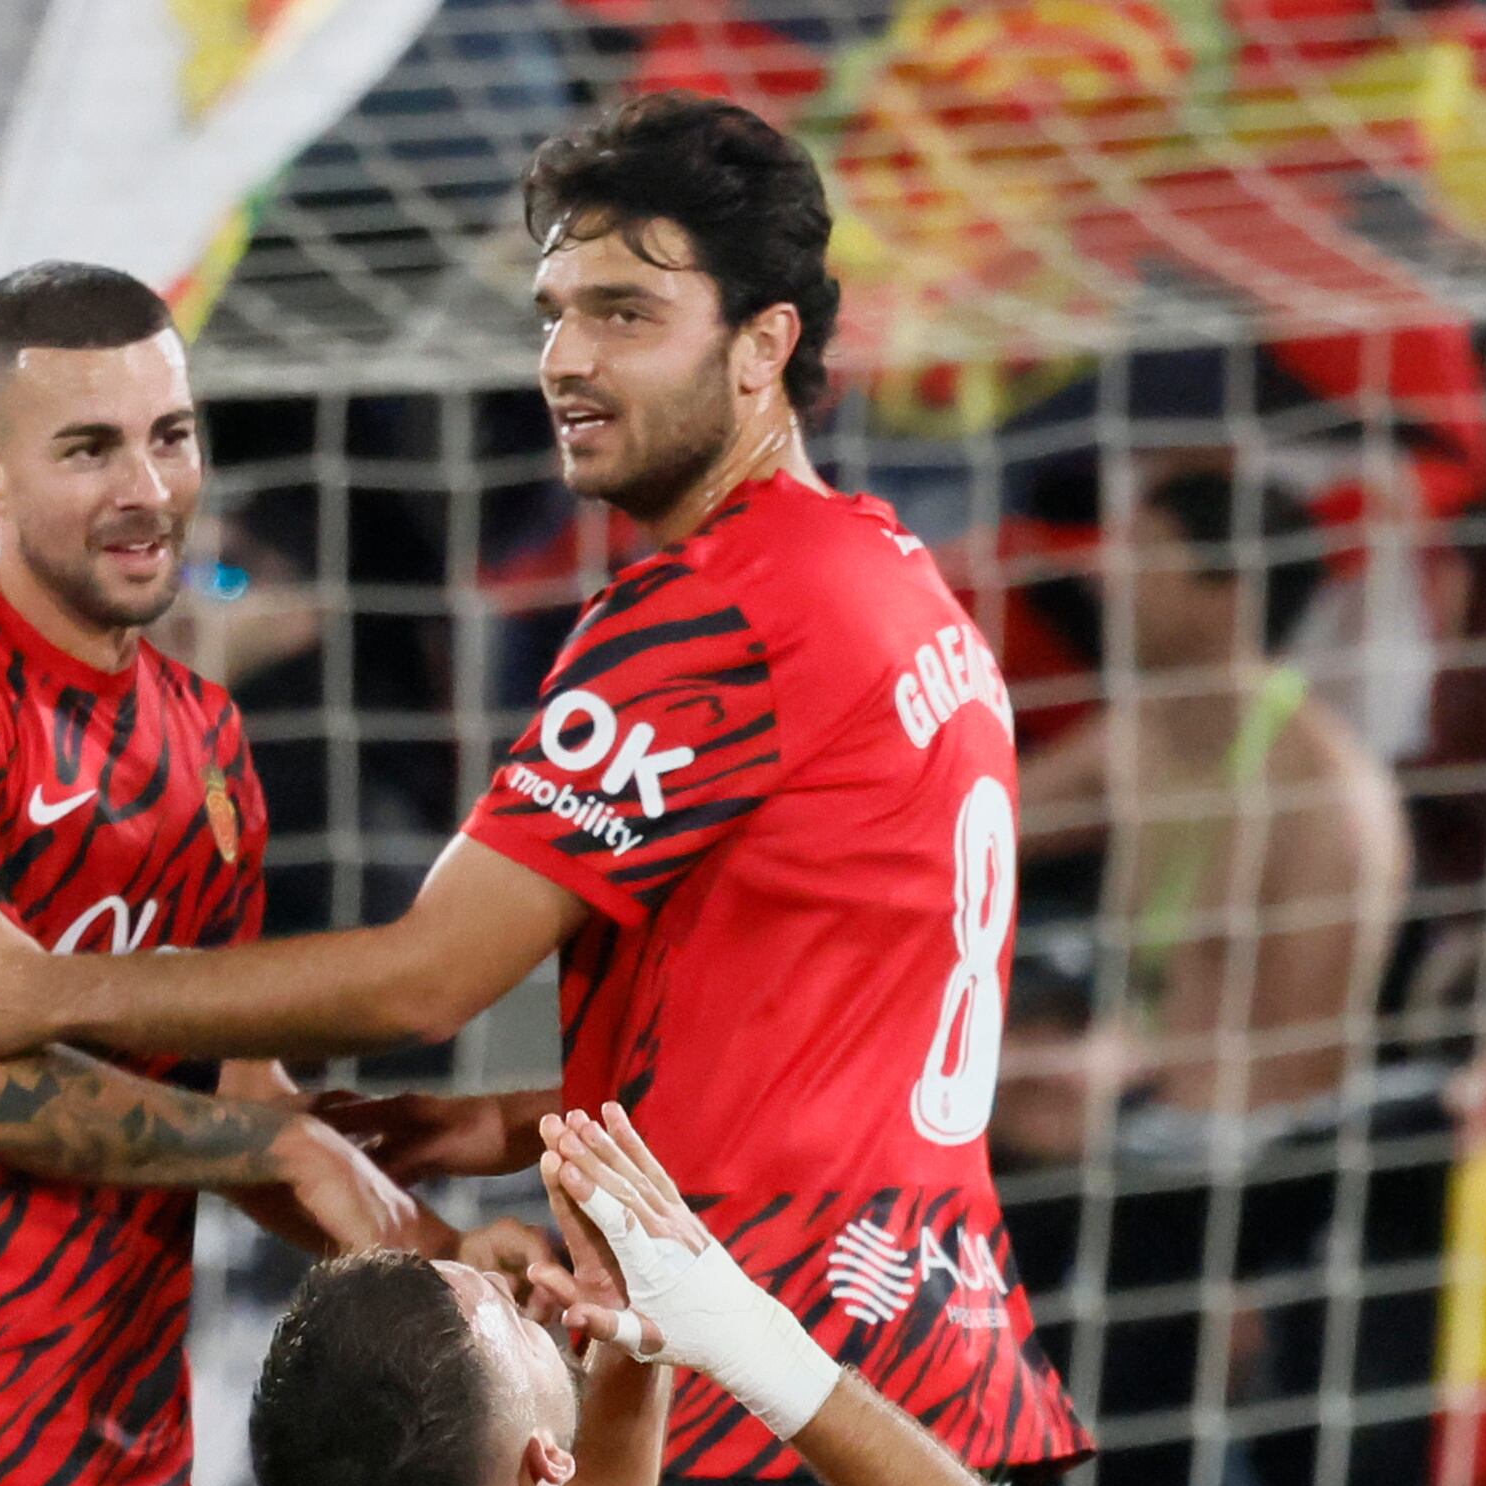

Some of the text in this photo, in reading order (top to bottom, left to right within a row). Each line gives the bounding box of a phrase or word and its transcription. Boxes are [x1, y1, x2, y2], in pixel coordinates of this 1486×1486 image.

[509, 766, 645, 857] mobility
[540, 689, 696, 819] OK
[911, 776, 1017, 1146] 8
